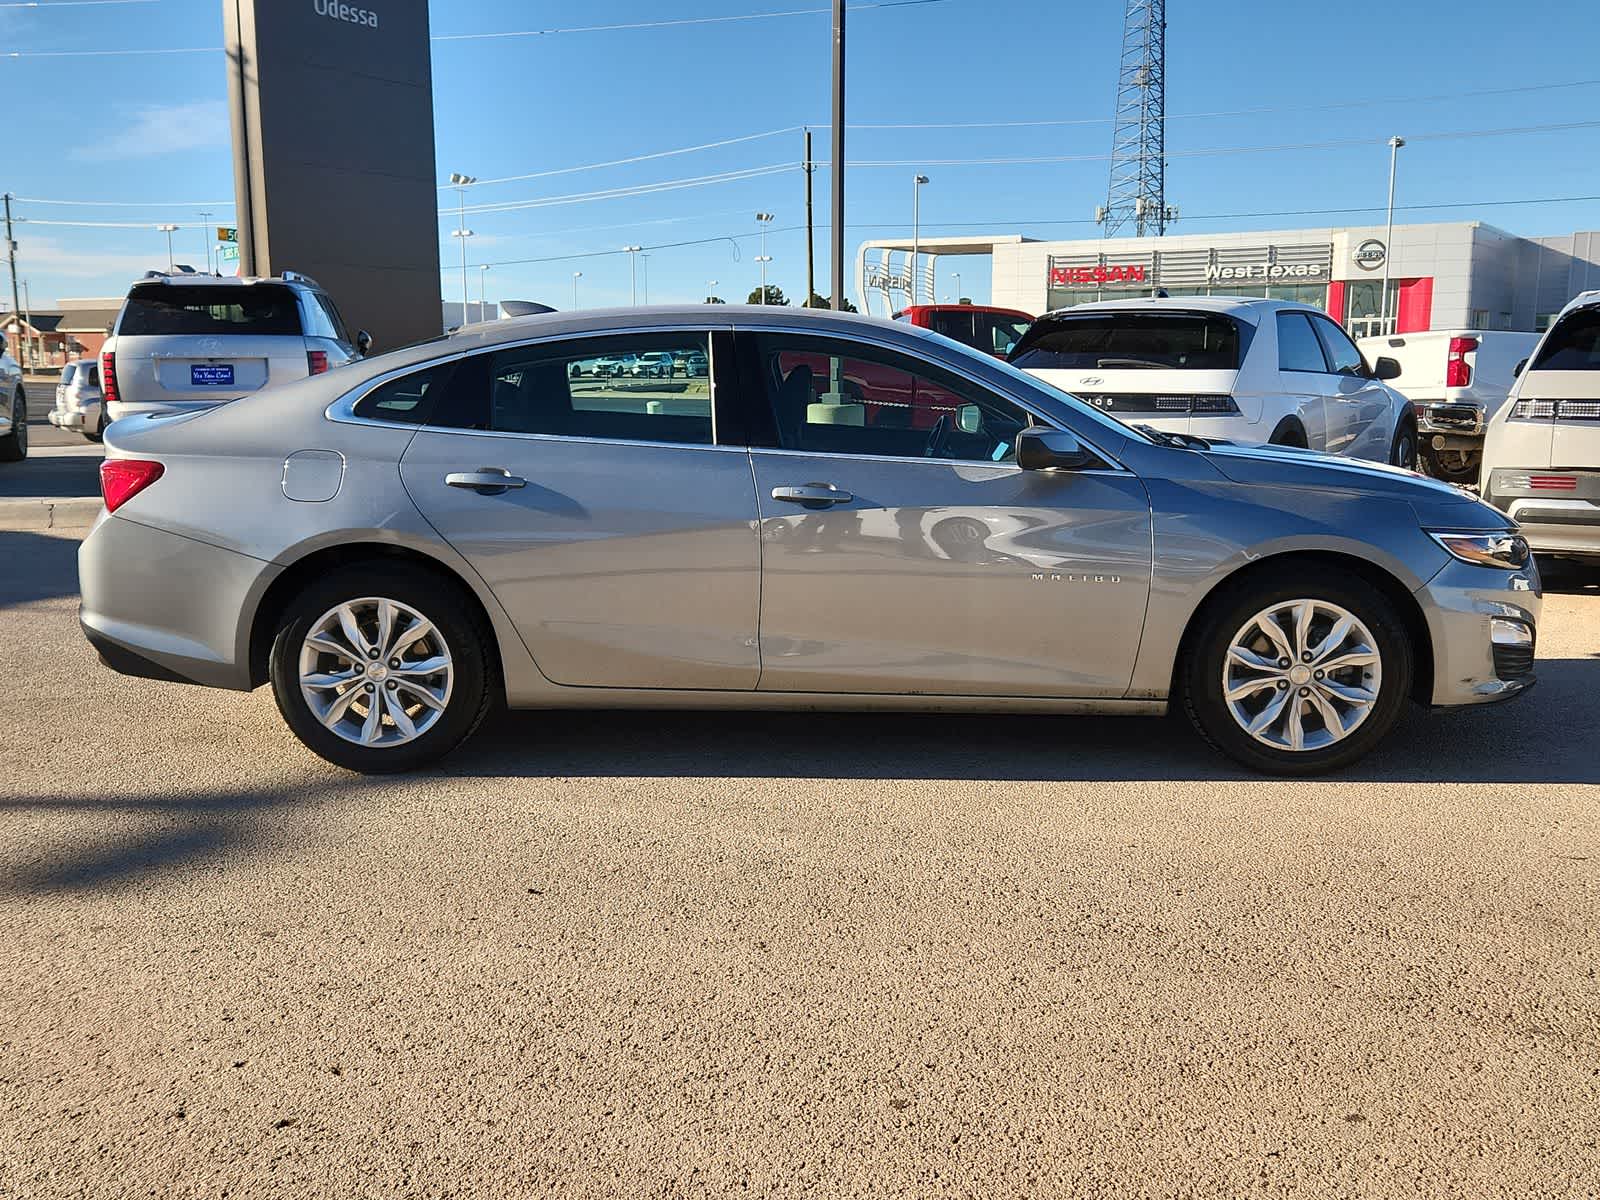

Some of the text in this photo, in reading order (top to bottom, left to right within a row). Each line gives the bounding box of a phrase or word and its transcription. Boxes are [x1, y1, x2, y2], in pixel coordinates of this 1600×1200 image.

[313, 0, 378, 28] Odessa
[1050, 264, 1145, 283] NISSAN
[1204, 263, 1321, 280] West Texas
[1031, 573, 1121, 583] MALIBU
